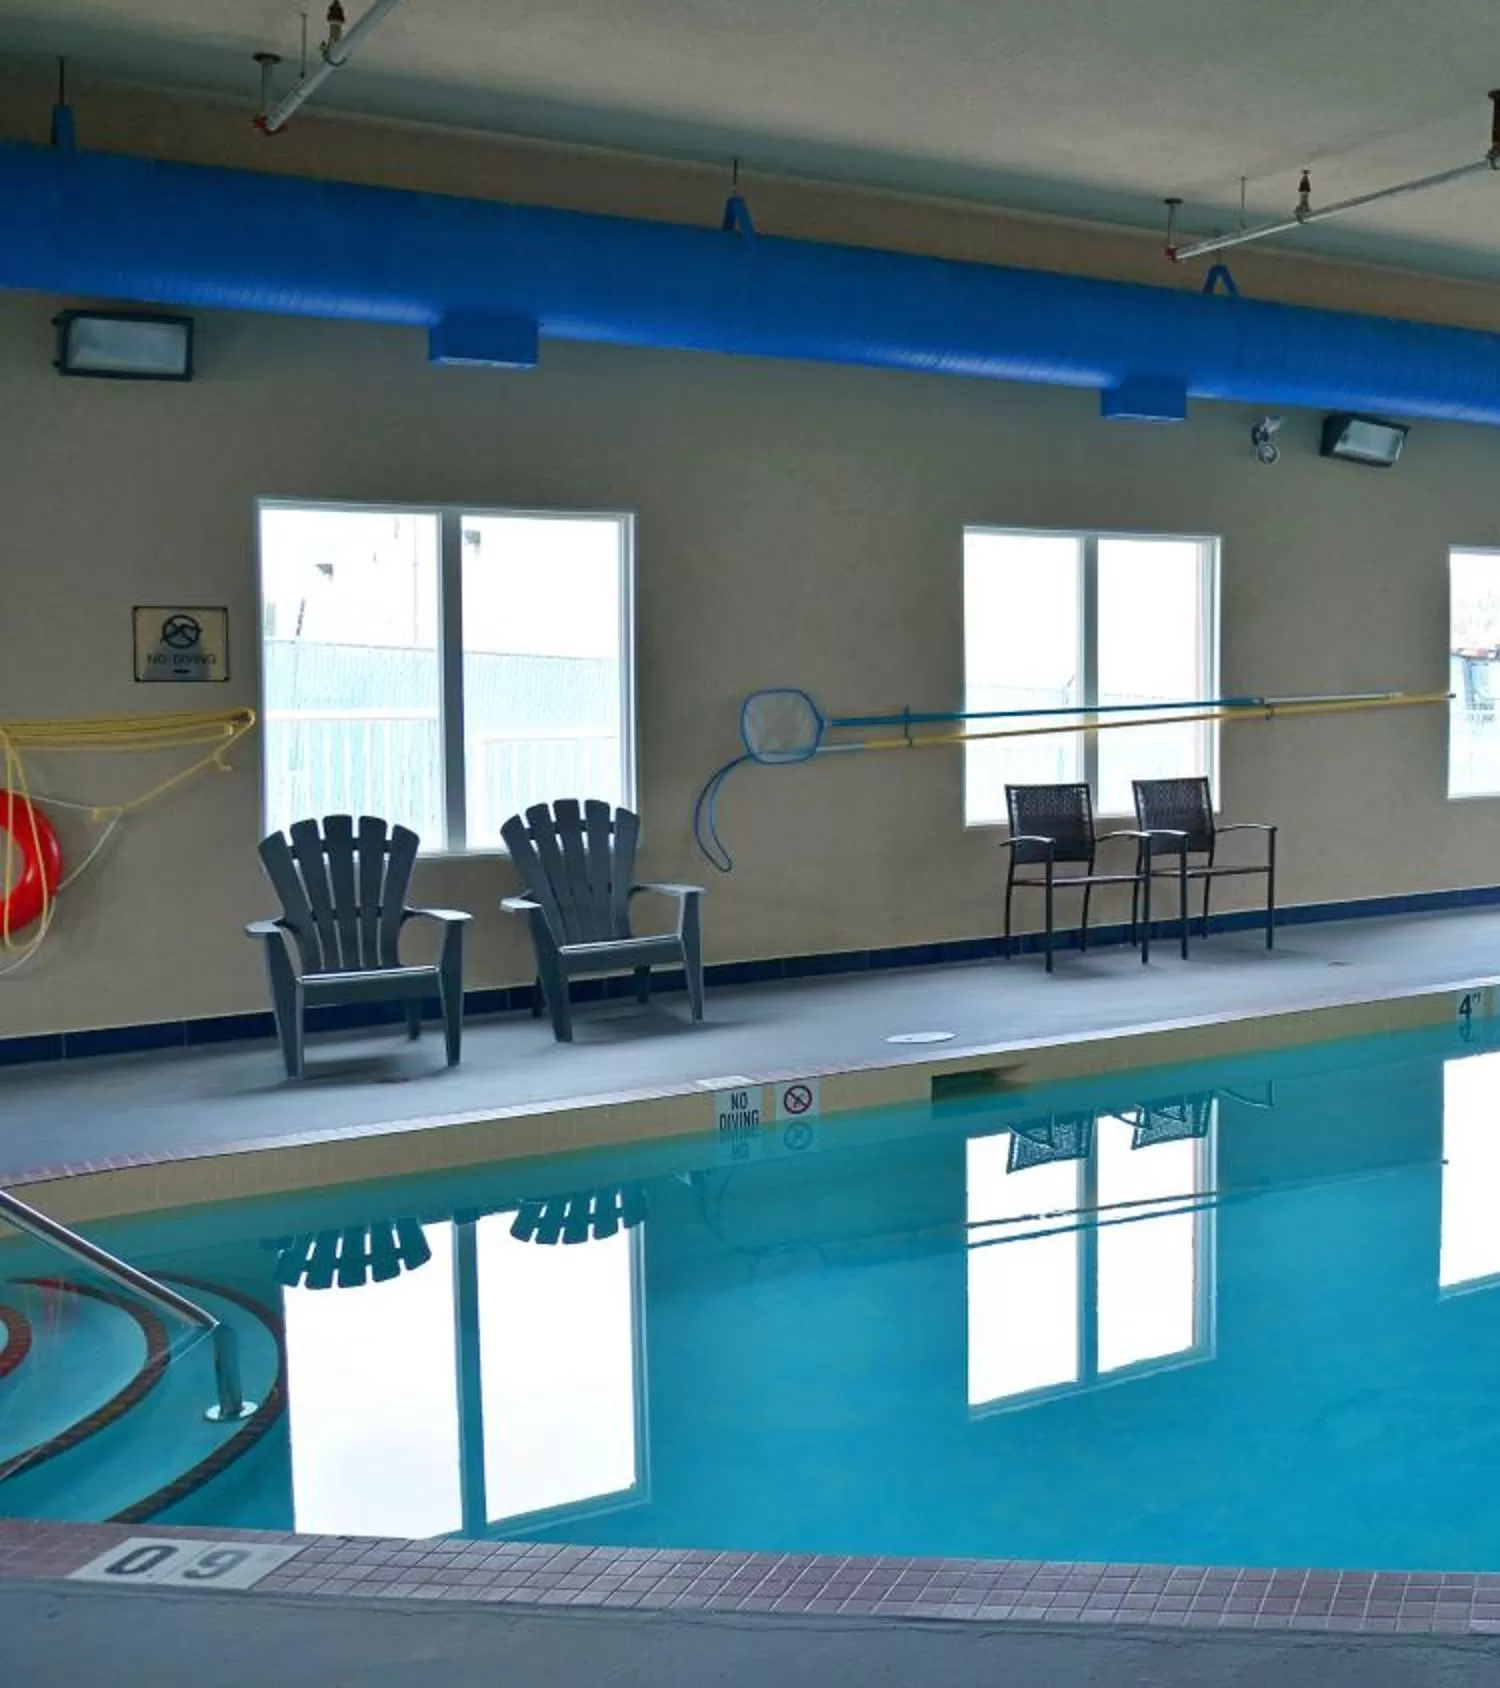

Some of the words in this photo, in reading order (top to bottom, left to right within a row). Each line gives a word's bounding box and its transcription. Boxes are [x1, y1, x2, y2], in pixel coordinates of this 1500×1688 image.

[146, 653, 167, 665] NO
[172, 653, 217, 665] DIVING
[731, 1091, 749, 1110] NO
[719, 1109, 760, 1132] DIVING
